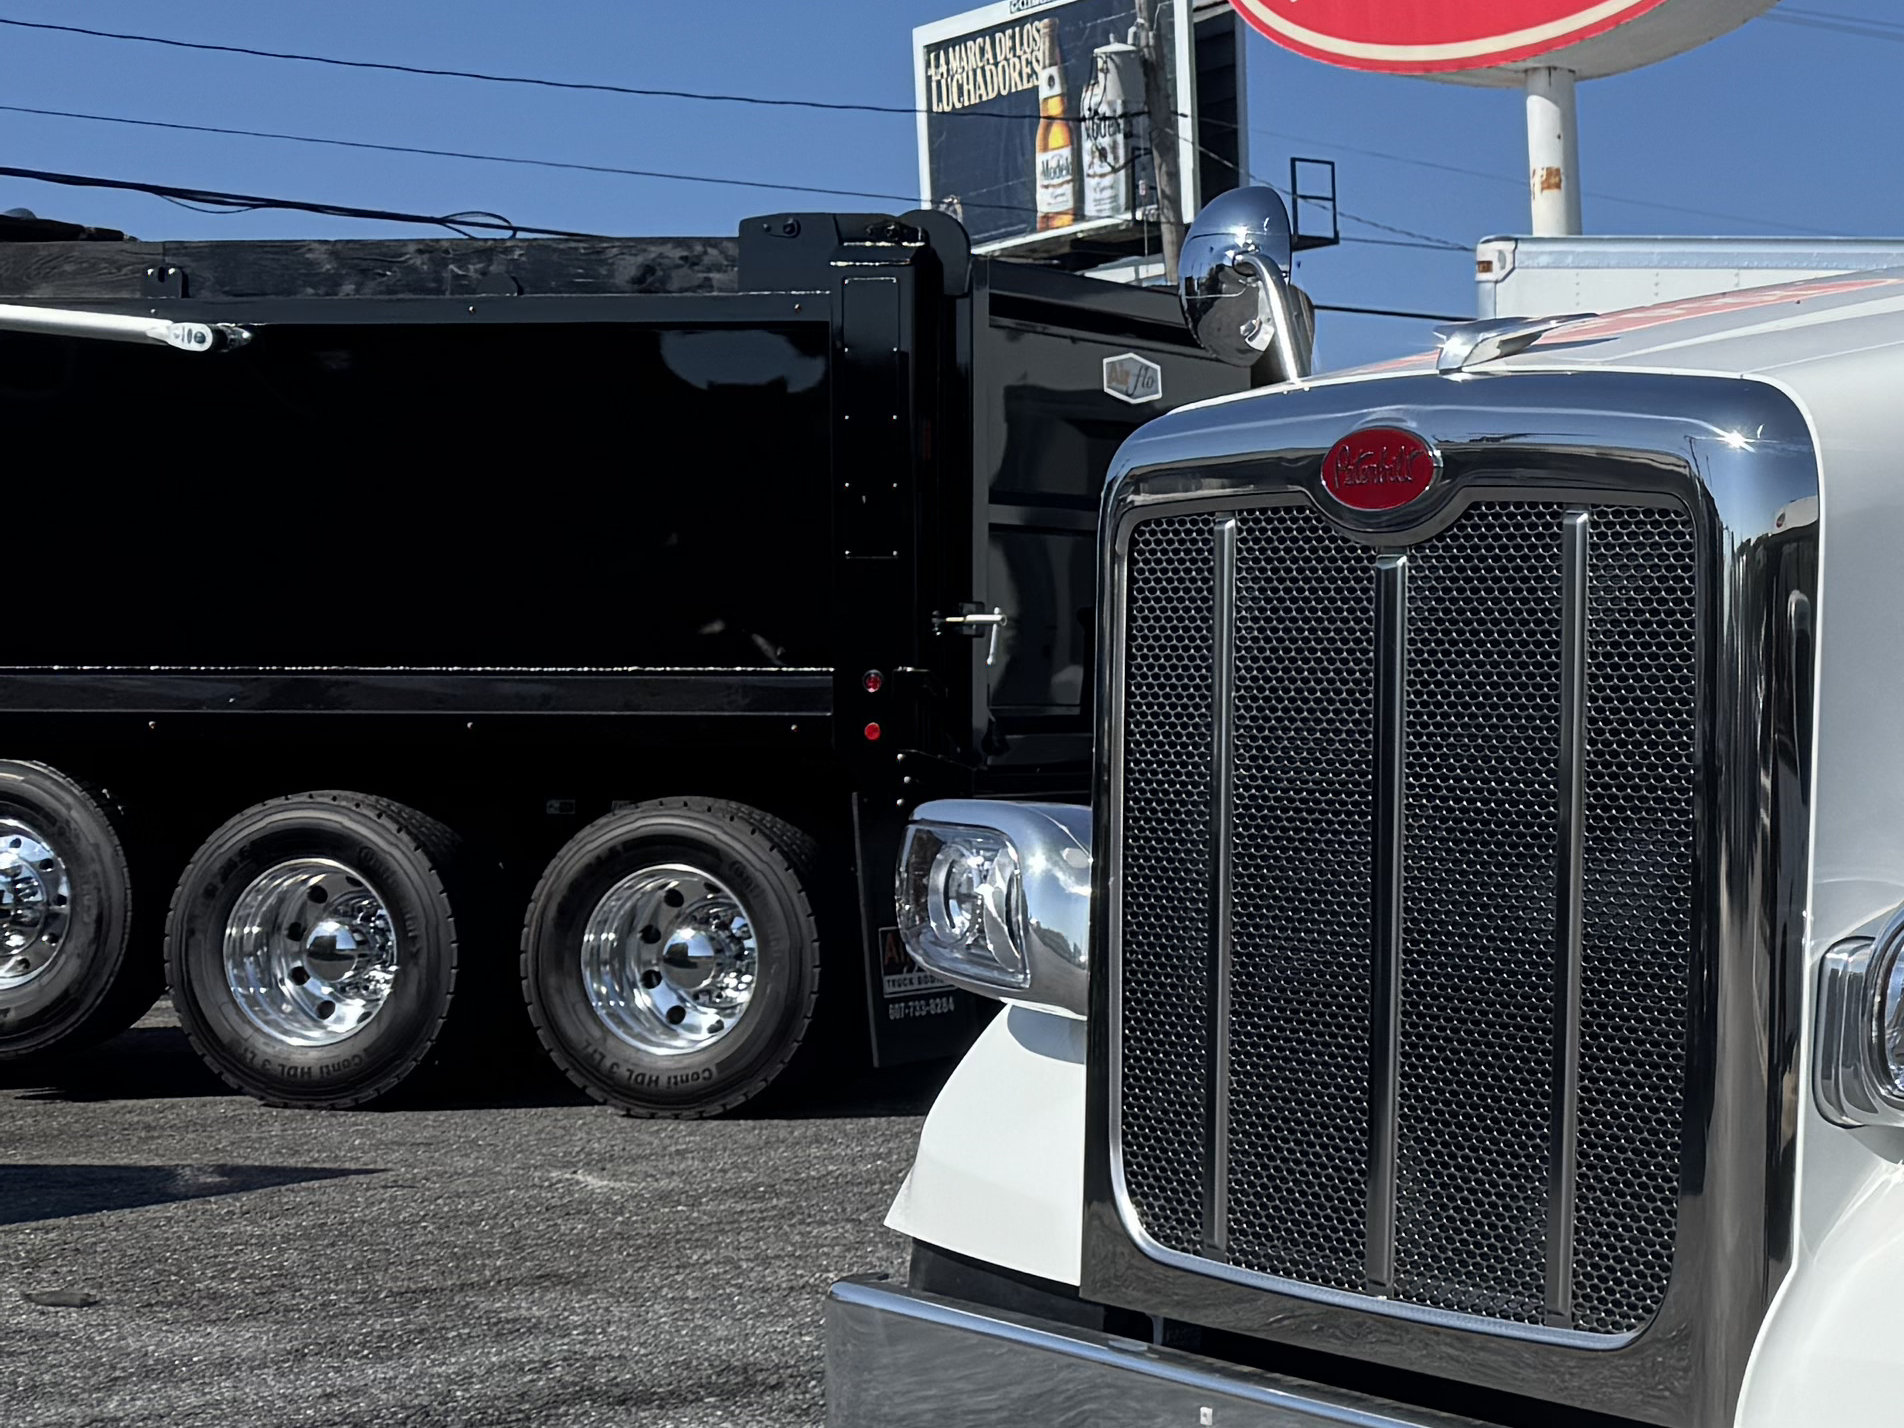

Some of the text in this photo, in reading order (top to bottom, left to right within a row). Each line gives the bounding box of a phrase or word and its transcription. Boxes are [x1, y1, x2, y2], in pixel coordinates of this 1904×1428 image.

[930, 20, 1040, 80] LA MARCA DE LOS
[931, 49, 1040, 112] LUCHADORES
[1334, 444, 1426, 489] Peterbilt
[886, 977, 914, 989] TRUCK
[261, 1058, 272, 1072] 3
[278, 1064, 312, 1079] HDL
[320, 1054, 363, 1079] Conti
[608, 1061, 621, 1075] 3
[625, 1068, 660, 1088] HDL
[667, 1067, 713, 1088] Conti
